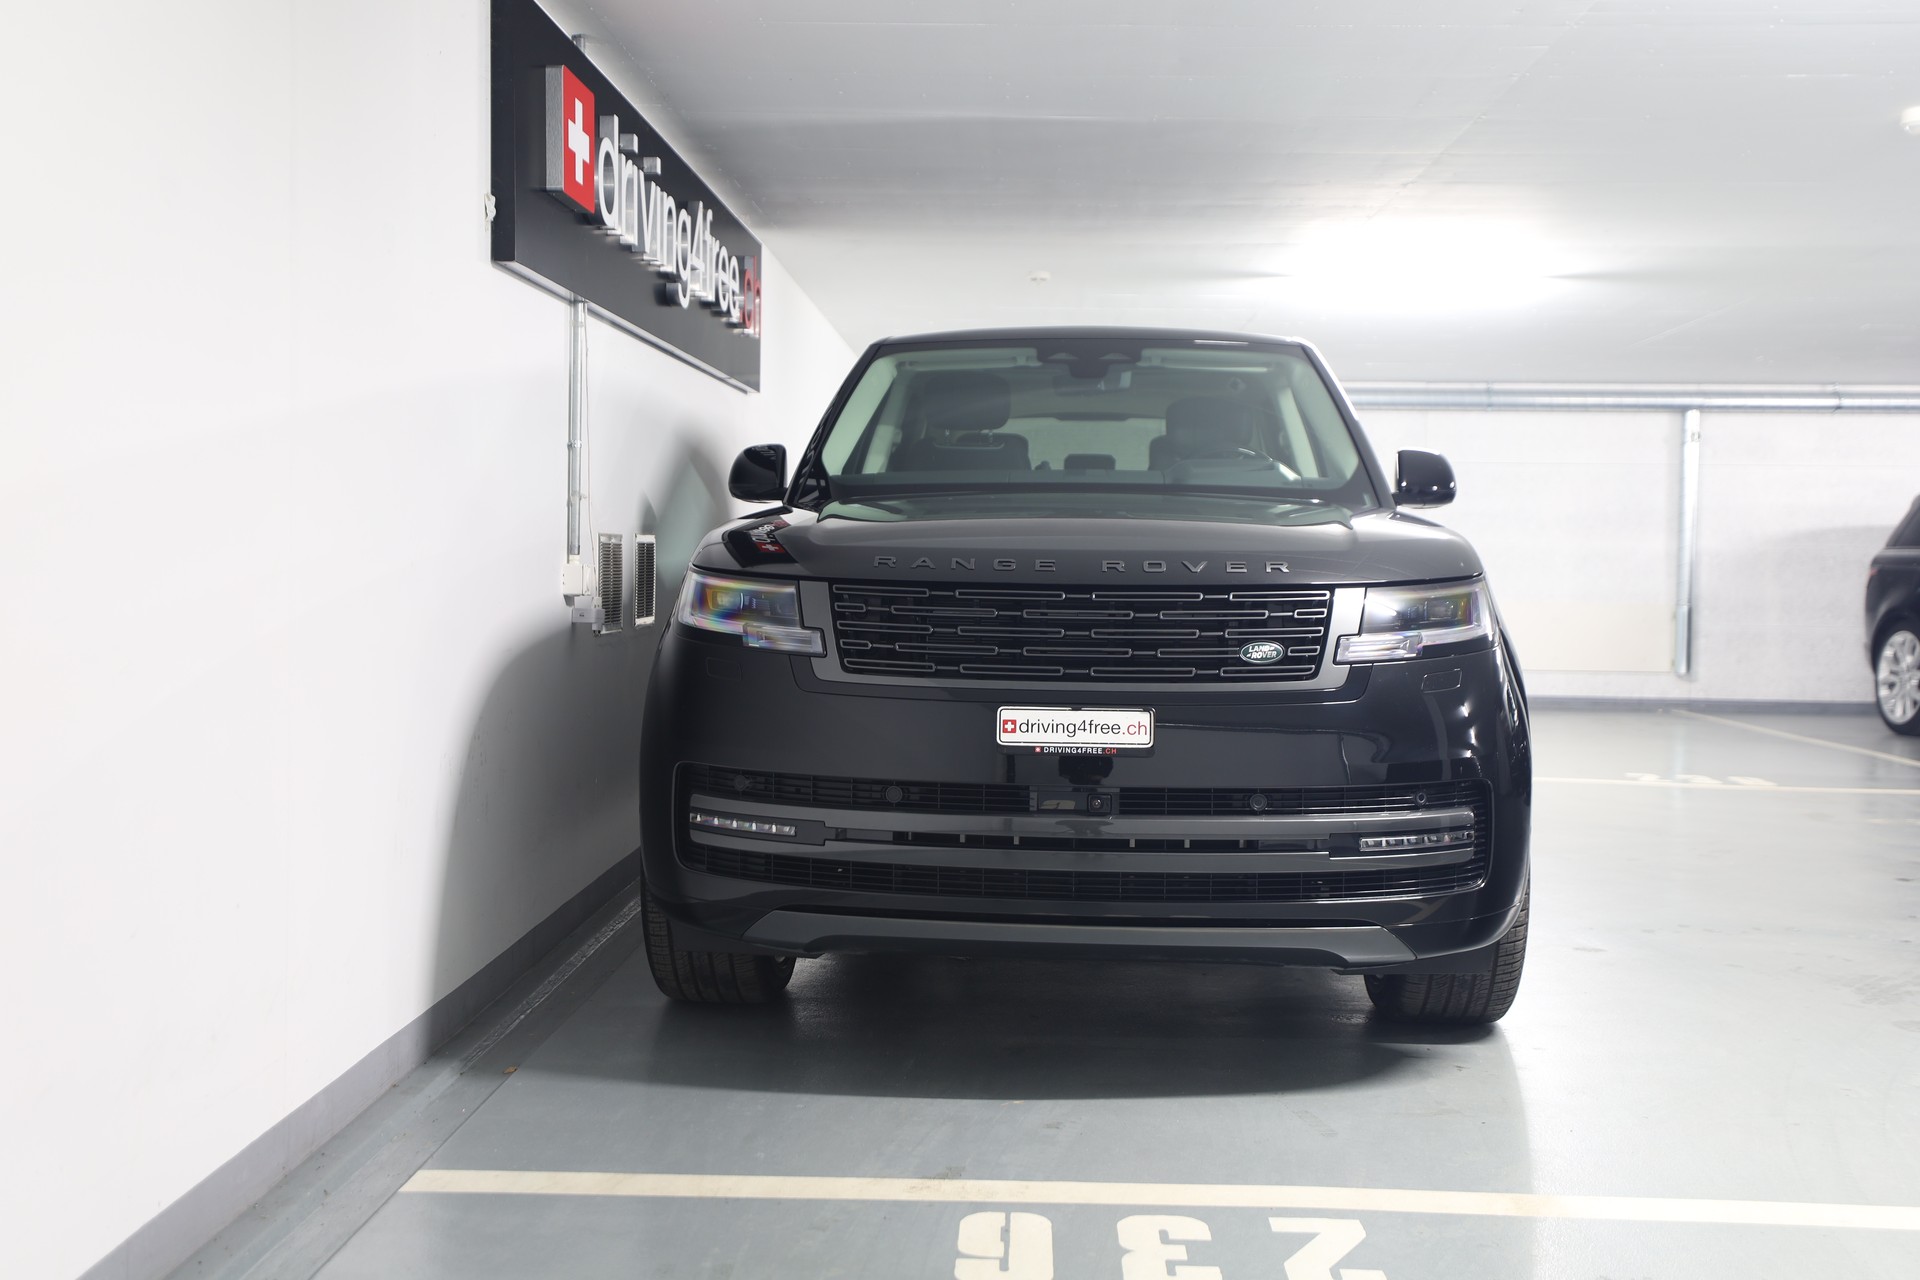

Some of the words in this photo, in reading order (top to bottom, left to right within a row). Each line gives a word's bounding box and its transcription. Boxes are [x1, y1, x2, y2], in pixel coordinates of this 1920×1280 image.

[598, 114, 761, 338] driving4free.ch
[873, 556, 1056, 573] RANGE
[1101, 559, 1290, 574] ROVER
[1251, 651, 1277, 659] ROVER
[1018, 719, 1147, 738] driving4free.ch
[1043, 746, 1117, 755] DRIVING4FREE.CH
